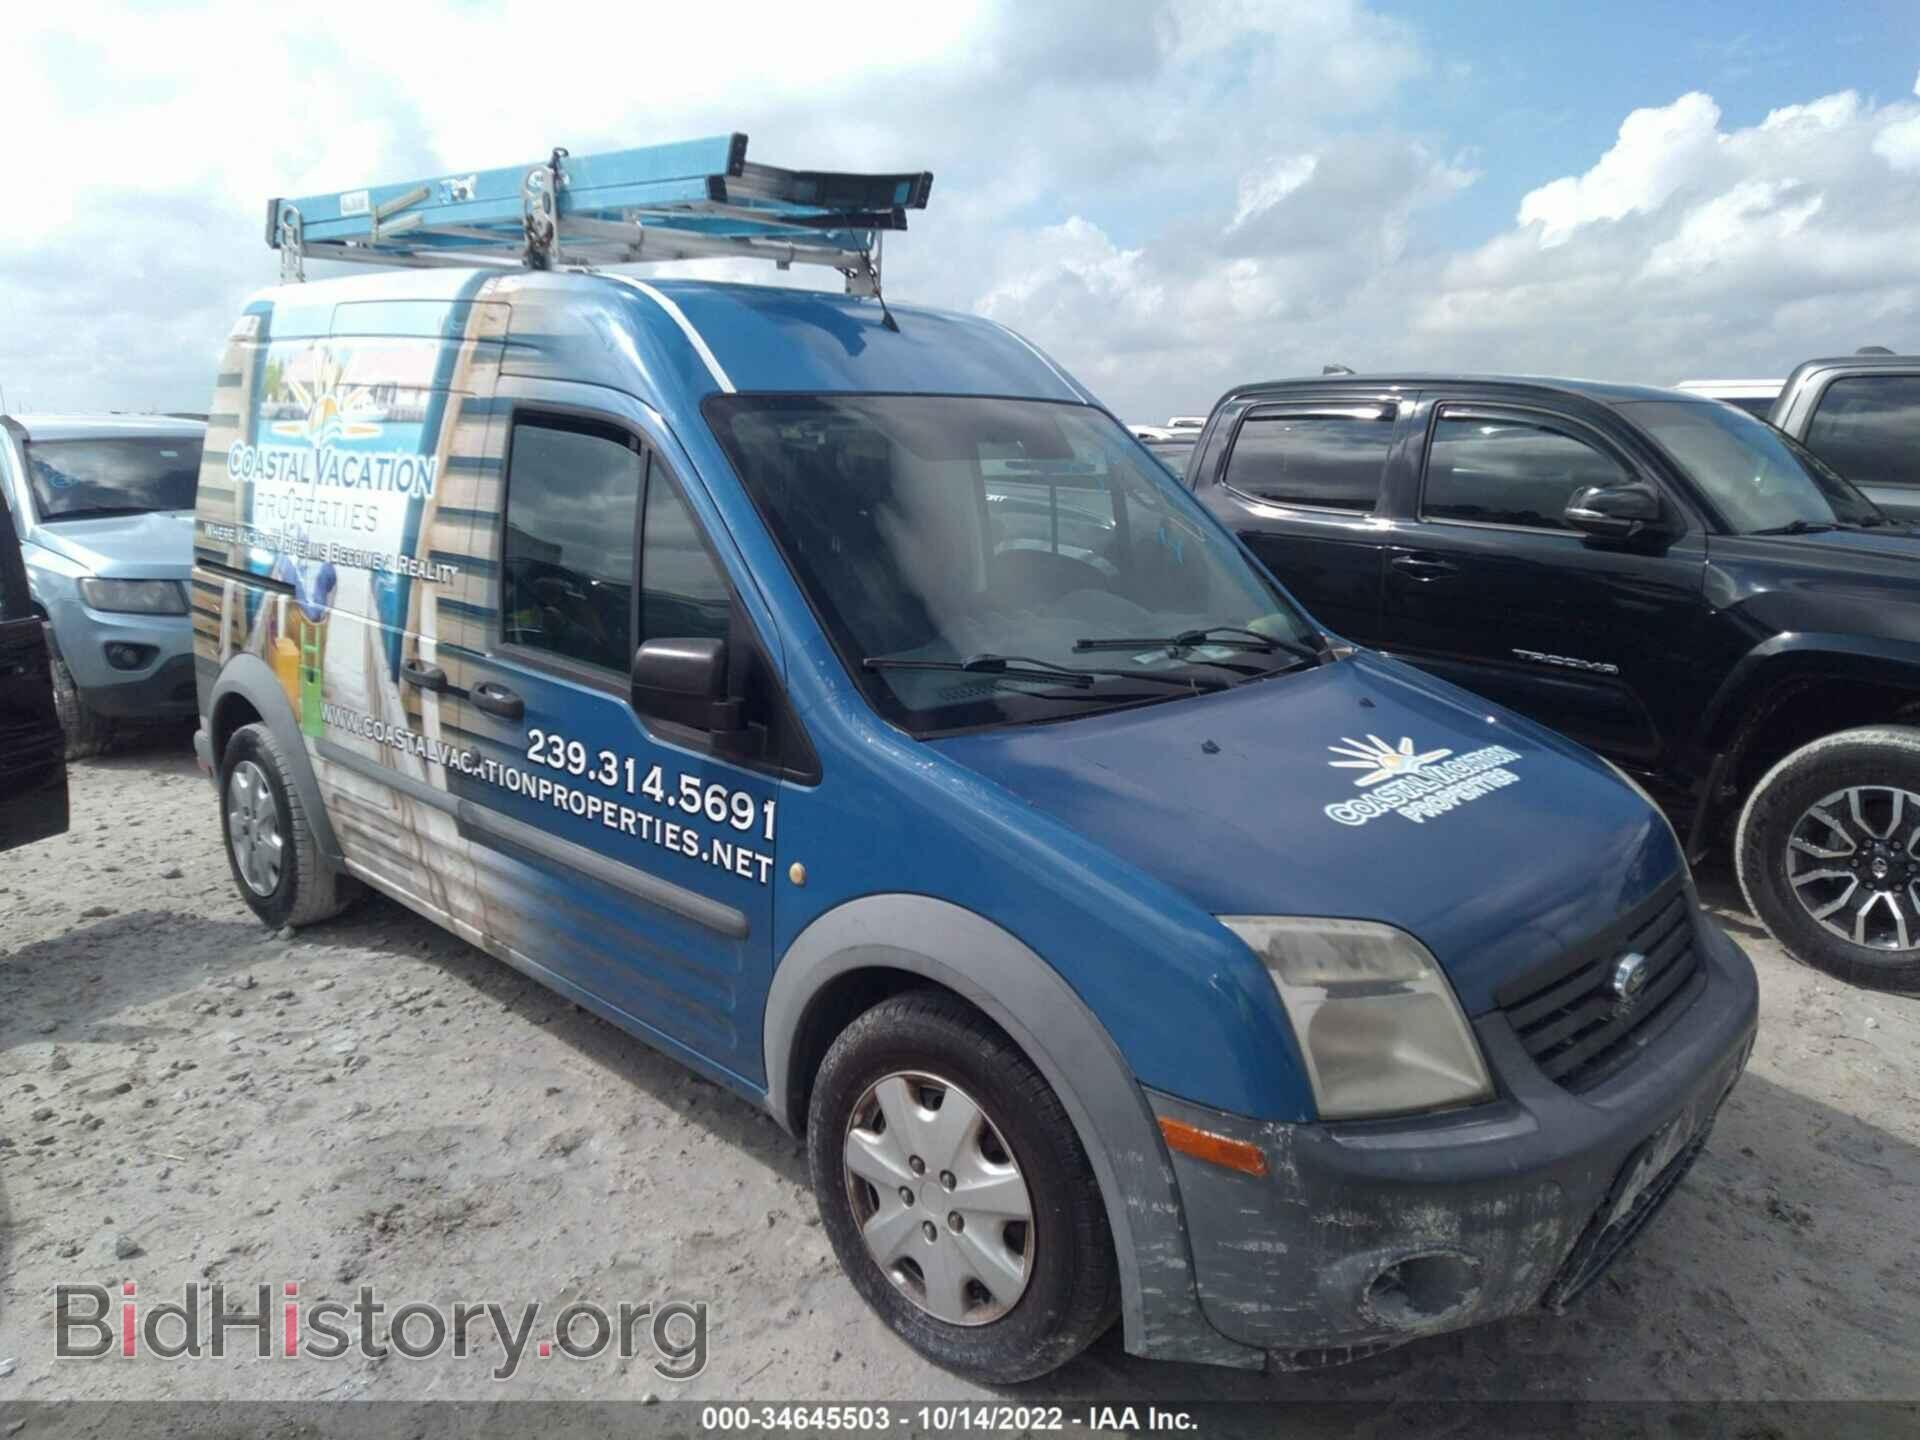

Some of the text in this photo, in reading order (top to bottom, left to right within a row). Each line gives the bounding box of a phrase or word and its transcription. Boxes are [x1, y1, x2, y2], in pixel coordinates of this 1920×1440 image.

[228, 445, 438, 496] COASTAL VACATION
[255, 490, 380, 533] PROPERTIES
[330, 543, 382, 572] BECOME
[398, 554, 459, 586] REALITY
[318, 702, 775, 885] WWW.COASTALVACATIONPROPERTIES.NET
[525, 727, 777, 842] 239.314.5691
